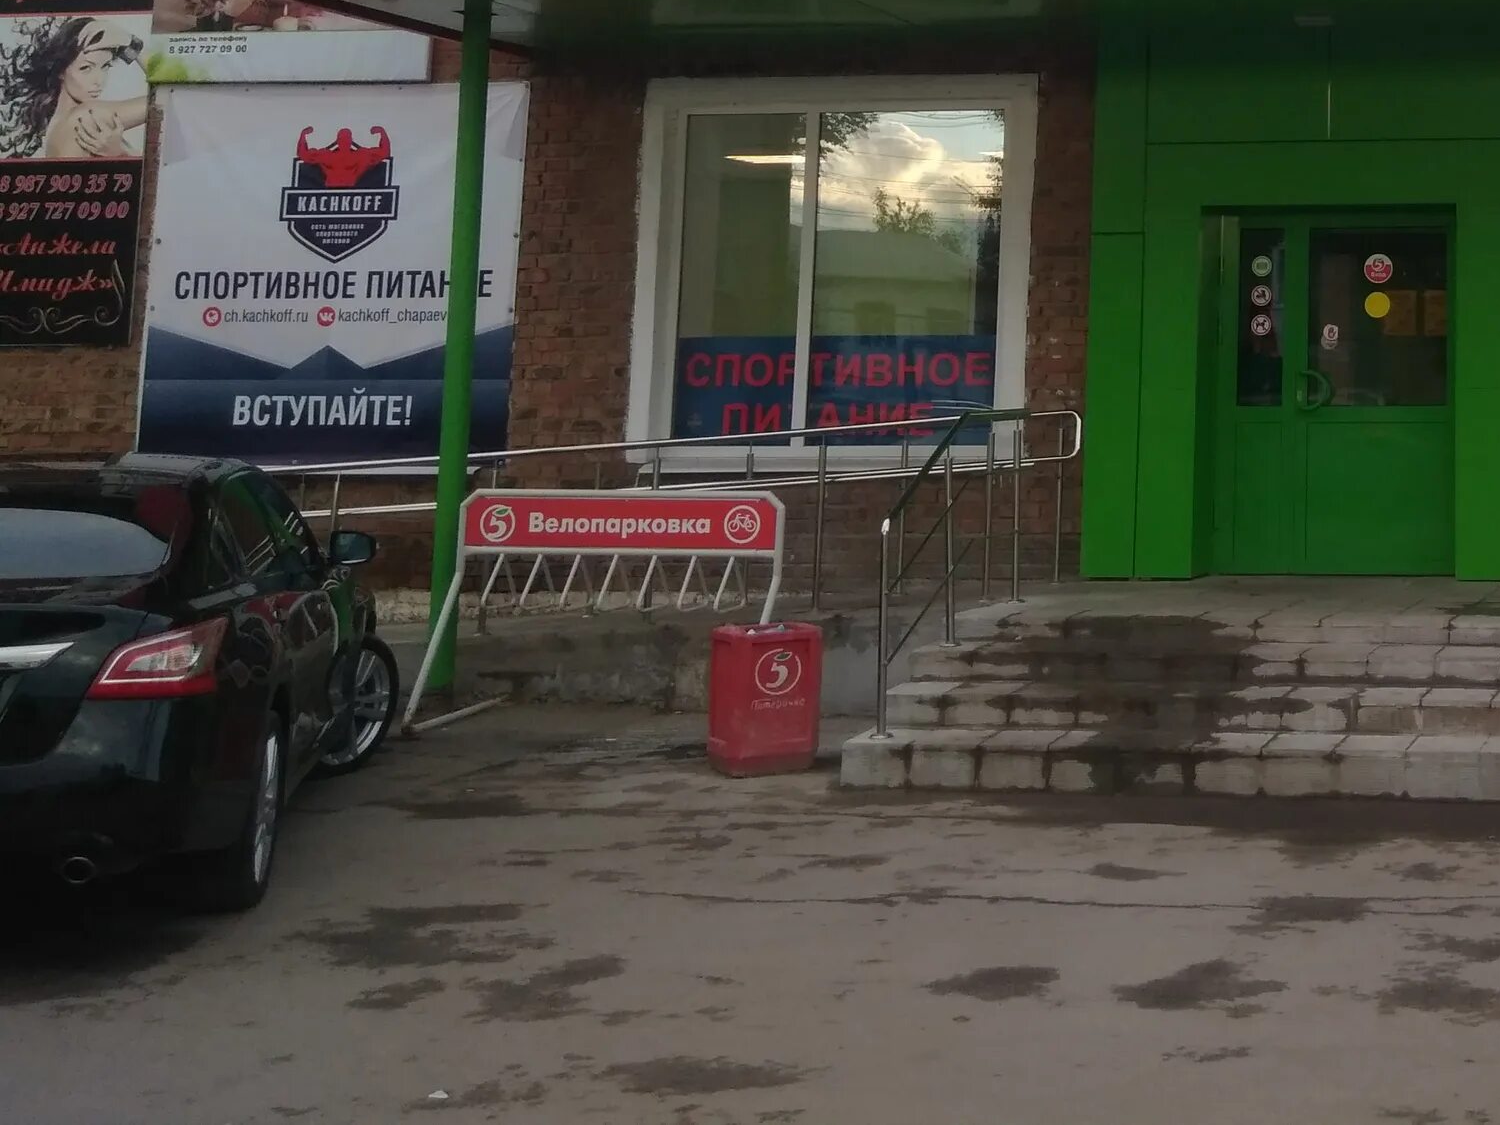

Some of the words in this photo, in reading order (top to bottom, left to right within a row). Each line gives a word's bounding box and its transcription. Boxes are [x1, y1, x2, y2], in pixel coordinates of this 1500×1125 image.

[168, 45, 175, 54] 8
[178, 45, 196, 54] 927
[199, 45, 217, 54] 727
[220, 44, 232, 53] 09
[235, 44, 248, 53] 00
[13, 174, 46, 194] 987
[48, 174, 82, 194] 909
[85, 174, 108, 194] 35
[113, 173, 133, 193] 79
[6, 202, 41, 222] 927
[45, 202, 75, 220] 727
[77, 201, 102, 221] 09
[105, 201, 130, 219] 00
[297, 195, 382, 212] KACHKOFF
[174, 270, 358, 300] СПОРТИВНОЕ
[366, 269, 493, 298] ПИТАНЕ
[224, 308, 308, 323] ch.kachkoff.ru
[686, 351, 992, 387] СПОРТИВНОЕ
[232, 387, 413, 426] ВСТУПАЙТЕ!
[721, 401, 935, 437] ПИАНИЕ
[528, 511, 711, 539] Велопарковка
